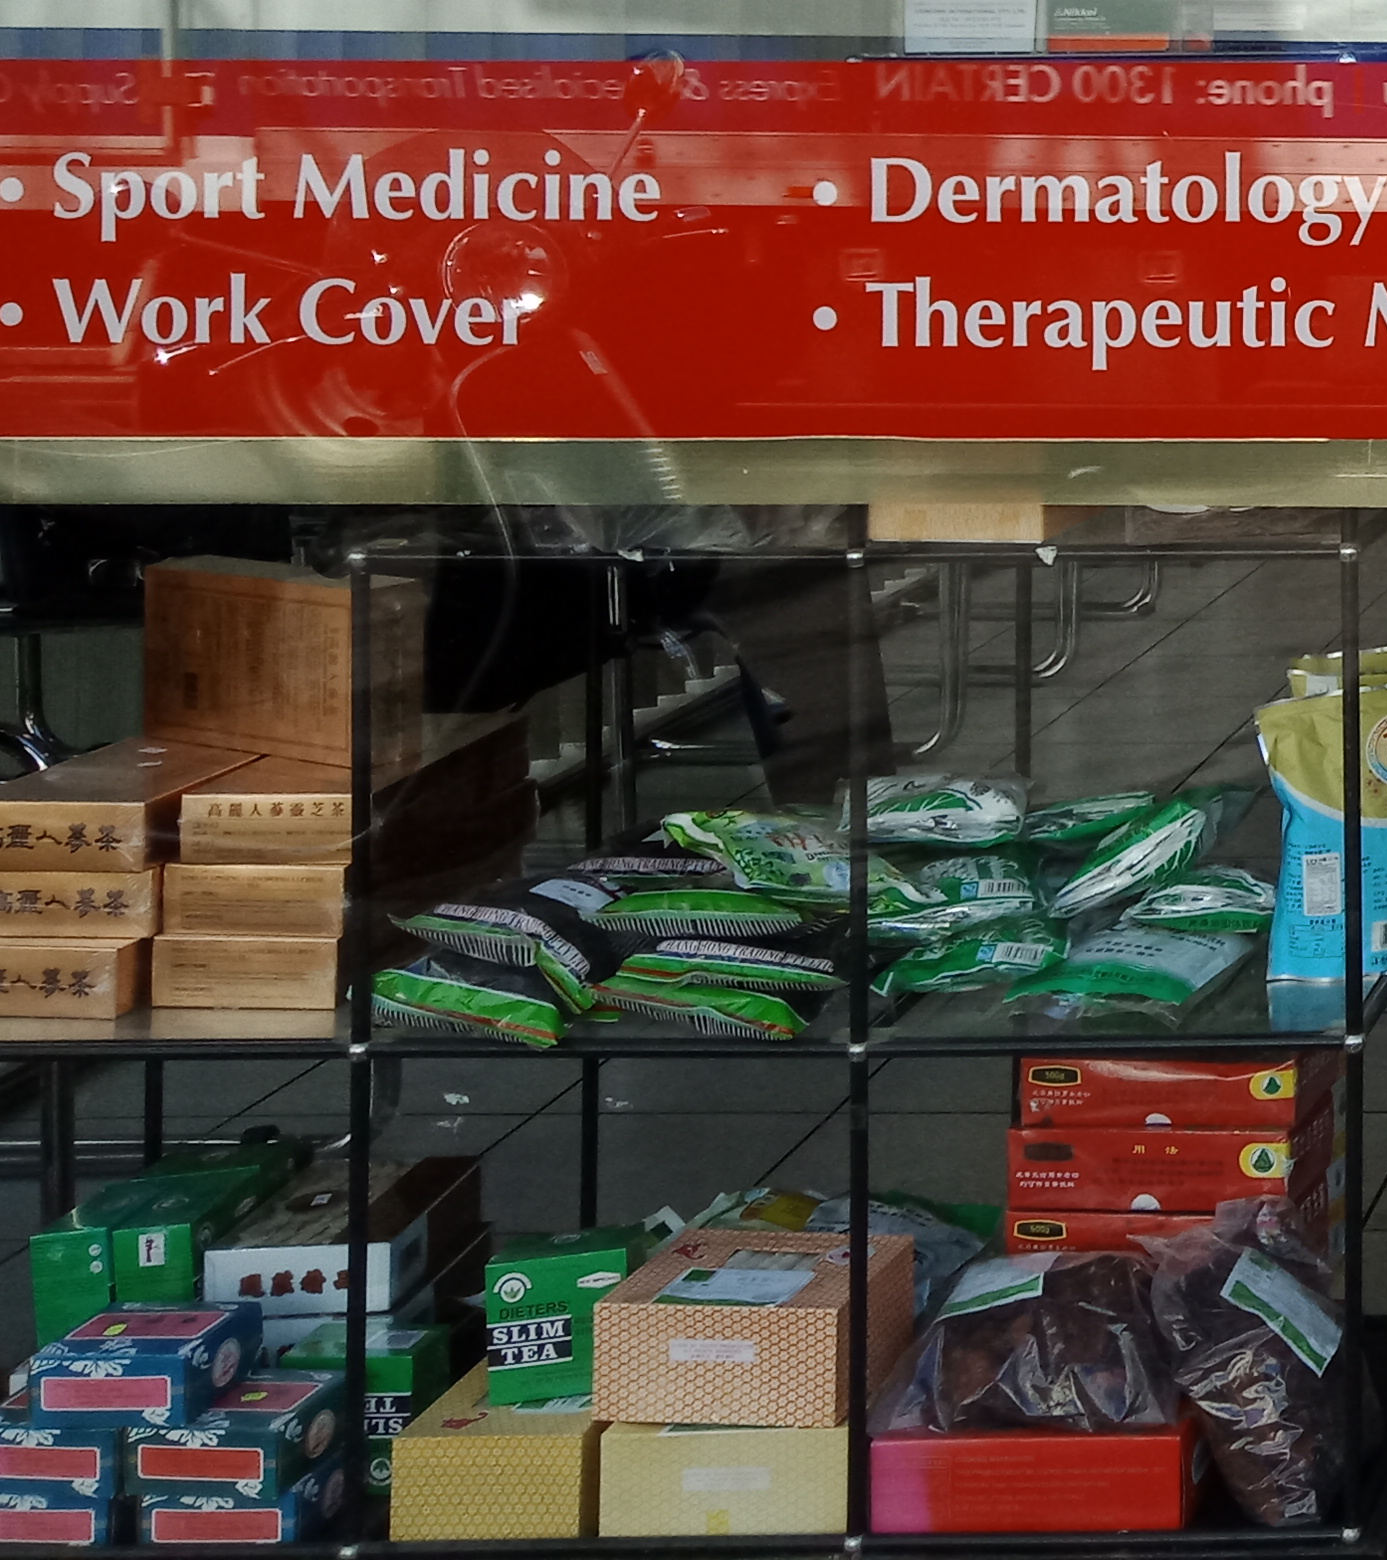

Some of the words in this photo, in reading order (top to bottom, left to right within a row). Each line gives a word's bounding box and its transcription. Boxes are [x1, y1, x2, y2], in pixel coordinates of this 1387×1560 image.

[52, 150, 267, 243] Sport
[292, 147, 663, 224] Medicine
[52, 273, 272, 347] Work
[299, 277, 530, 348] Cover
[865, 275, 1336, 372] Therapeutic
[491, 1320, 567, 1344] SLIM
[499, 1299, 569, 1321] DIETERS
[499, 1342, 558, 1366] TEA
